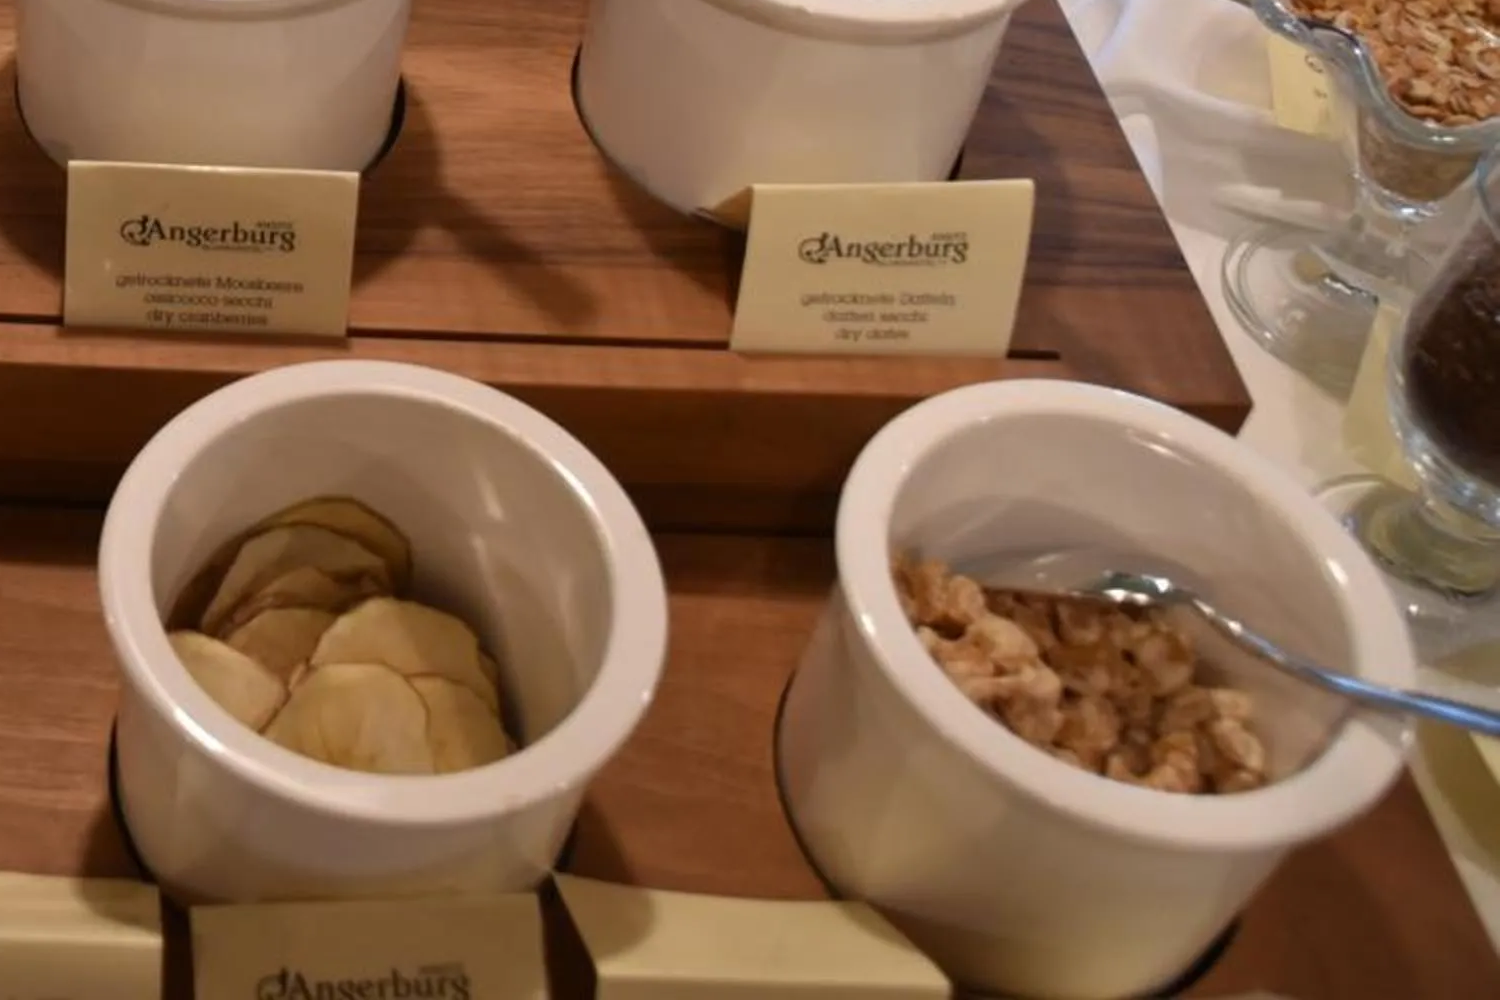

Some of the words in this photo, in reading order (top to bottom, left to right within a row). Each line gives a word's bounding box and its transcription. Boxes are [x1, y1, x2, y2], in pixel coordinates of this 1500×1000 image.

[120, 215, 297, 251] Angerburg
[799, 232, 969, 265] Angerburg
[145, 309, 174, 326] dry
[835, 327, 862, 341] dry
